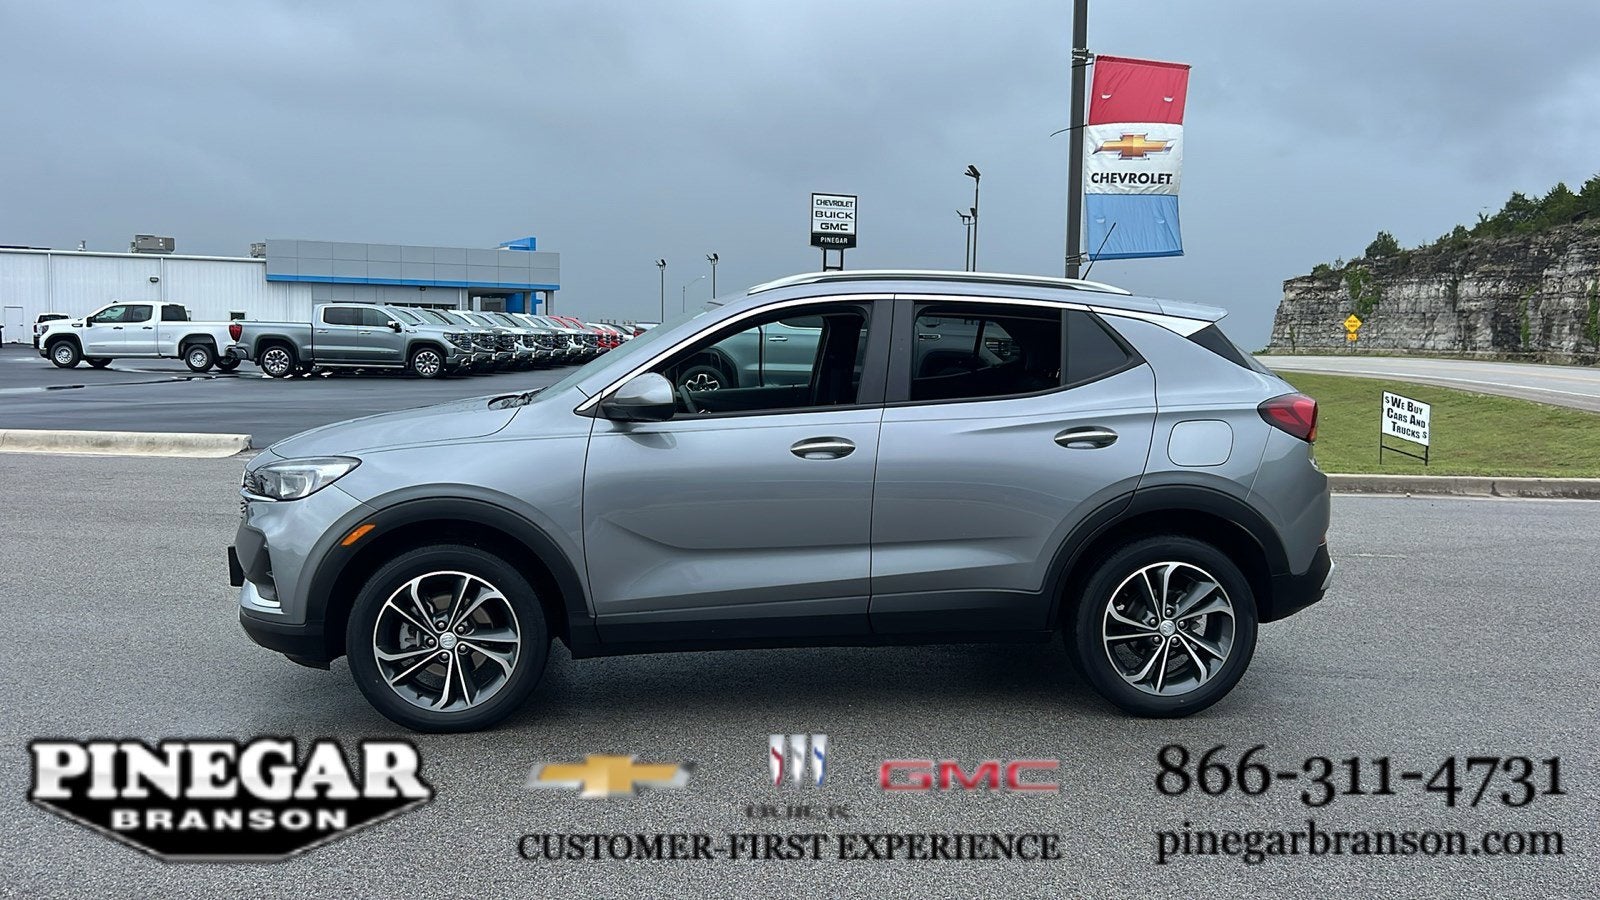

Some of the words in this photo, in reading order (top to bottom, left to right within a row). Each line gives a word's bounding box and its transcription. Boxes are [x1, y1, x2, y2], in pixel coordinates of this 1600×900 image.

[1091, 172, 1173, 185] CHEVROLET
[816, 199, 854, 208] CHEVROLET
[815, 210, 854, 220] BUICK
[820, 222, 849, 231] GMC
[820, 236, 848, 244] PINEGAR
[1407, 401, 1423, 415] BUY
[1387, 407, 1407, 423] CARS
[1410, 414, 1426, 429] AND
[1391, 421, 1420, 439] TRUCKS
